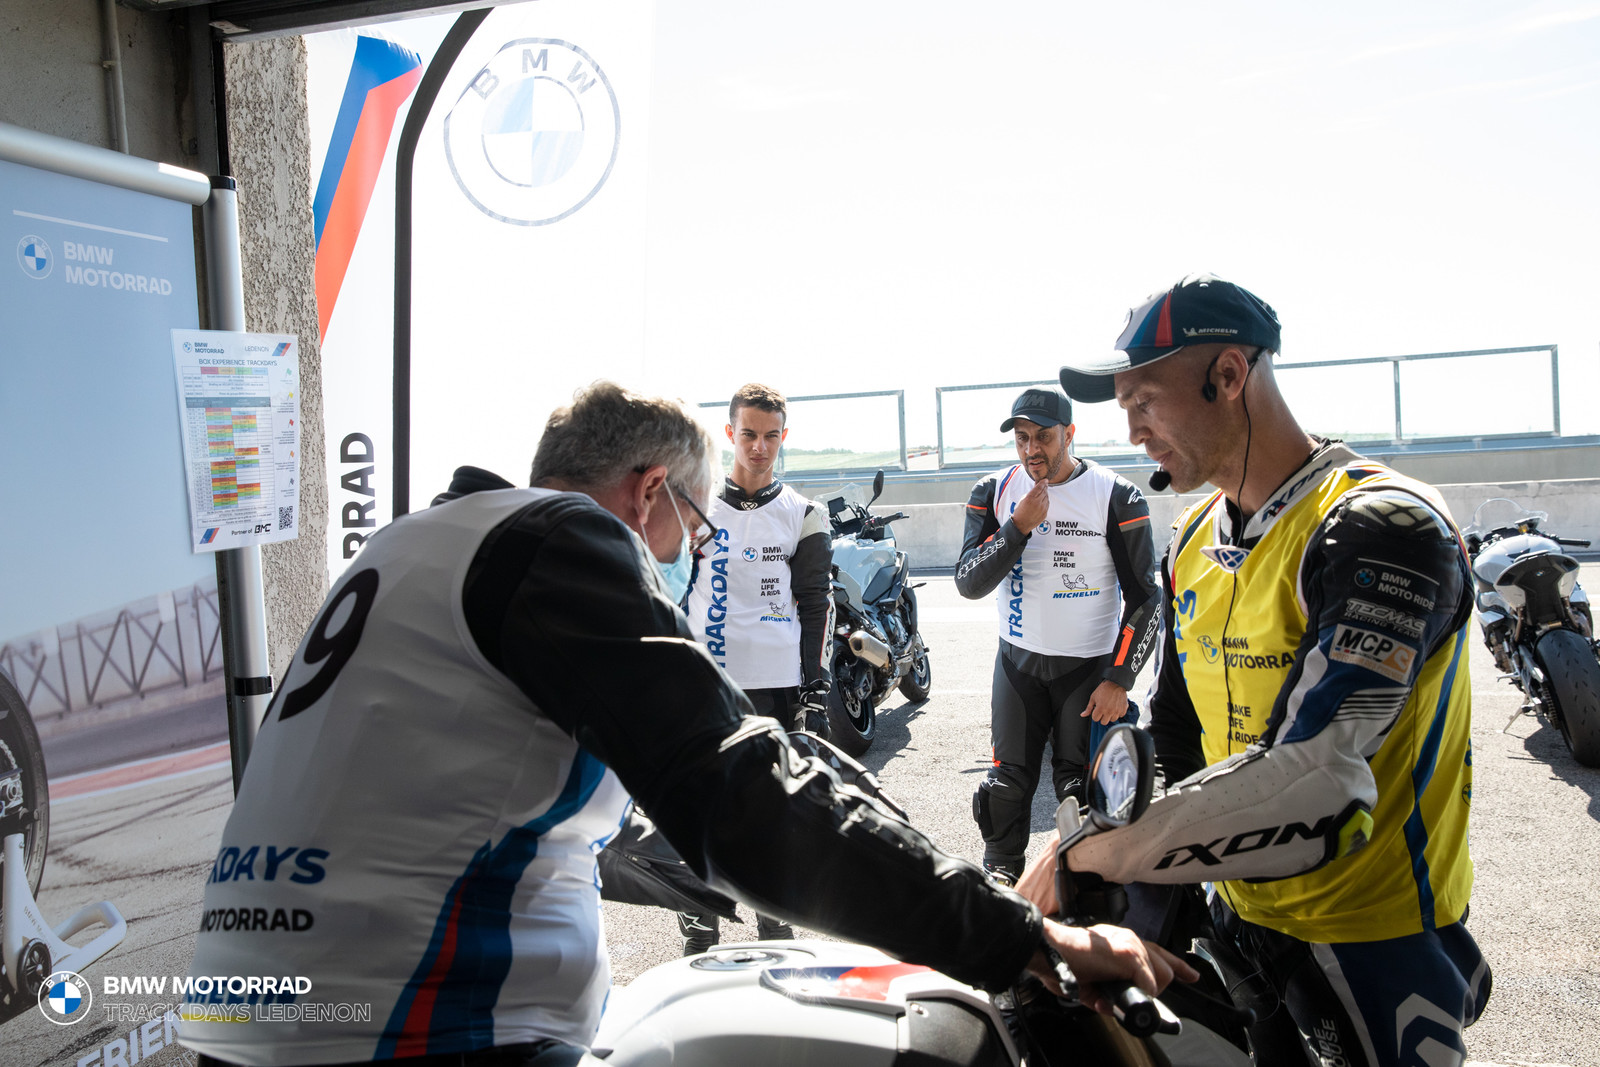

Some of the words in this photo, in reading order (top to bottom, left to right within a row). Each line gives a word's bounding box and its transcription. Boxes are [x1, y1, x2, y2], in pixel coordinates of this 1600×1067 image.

[470, 49, 597, 100] BMW
[63, 241, 113, 265] BMW
[65, 265, 172, 296] MOTORRAD
[254, 523, 271, 534] BMC
[1381, 572, 1411, 588] BMW
[1053, 590, 1100, 599] MICHELIN
[1377, 583, 1413, 601] MOTO
[1413, 594, 1435, 611] RIDE
[1344, 612, 1388, 627] RACING
[1392, 625, 1420, 639] TEAM
[1346, 598, 1427, 633] TECMAS
[278, 568, 379, 722] 9
[1337, 629, 1394, 657] MCP
[1225, 651, 1297, 669] MOTORRA
[1235, 731, 1259, 744] RIDE
